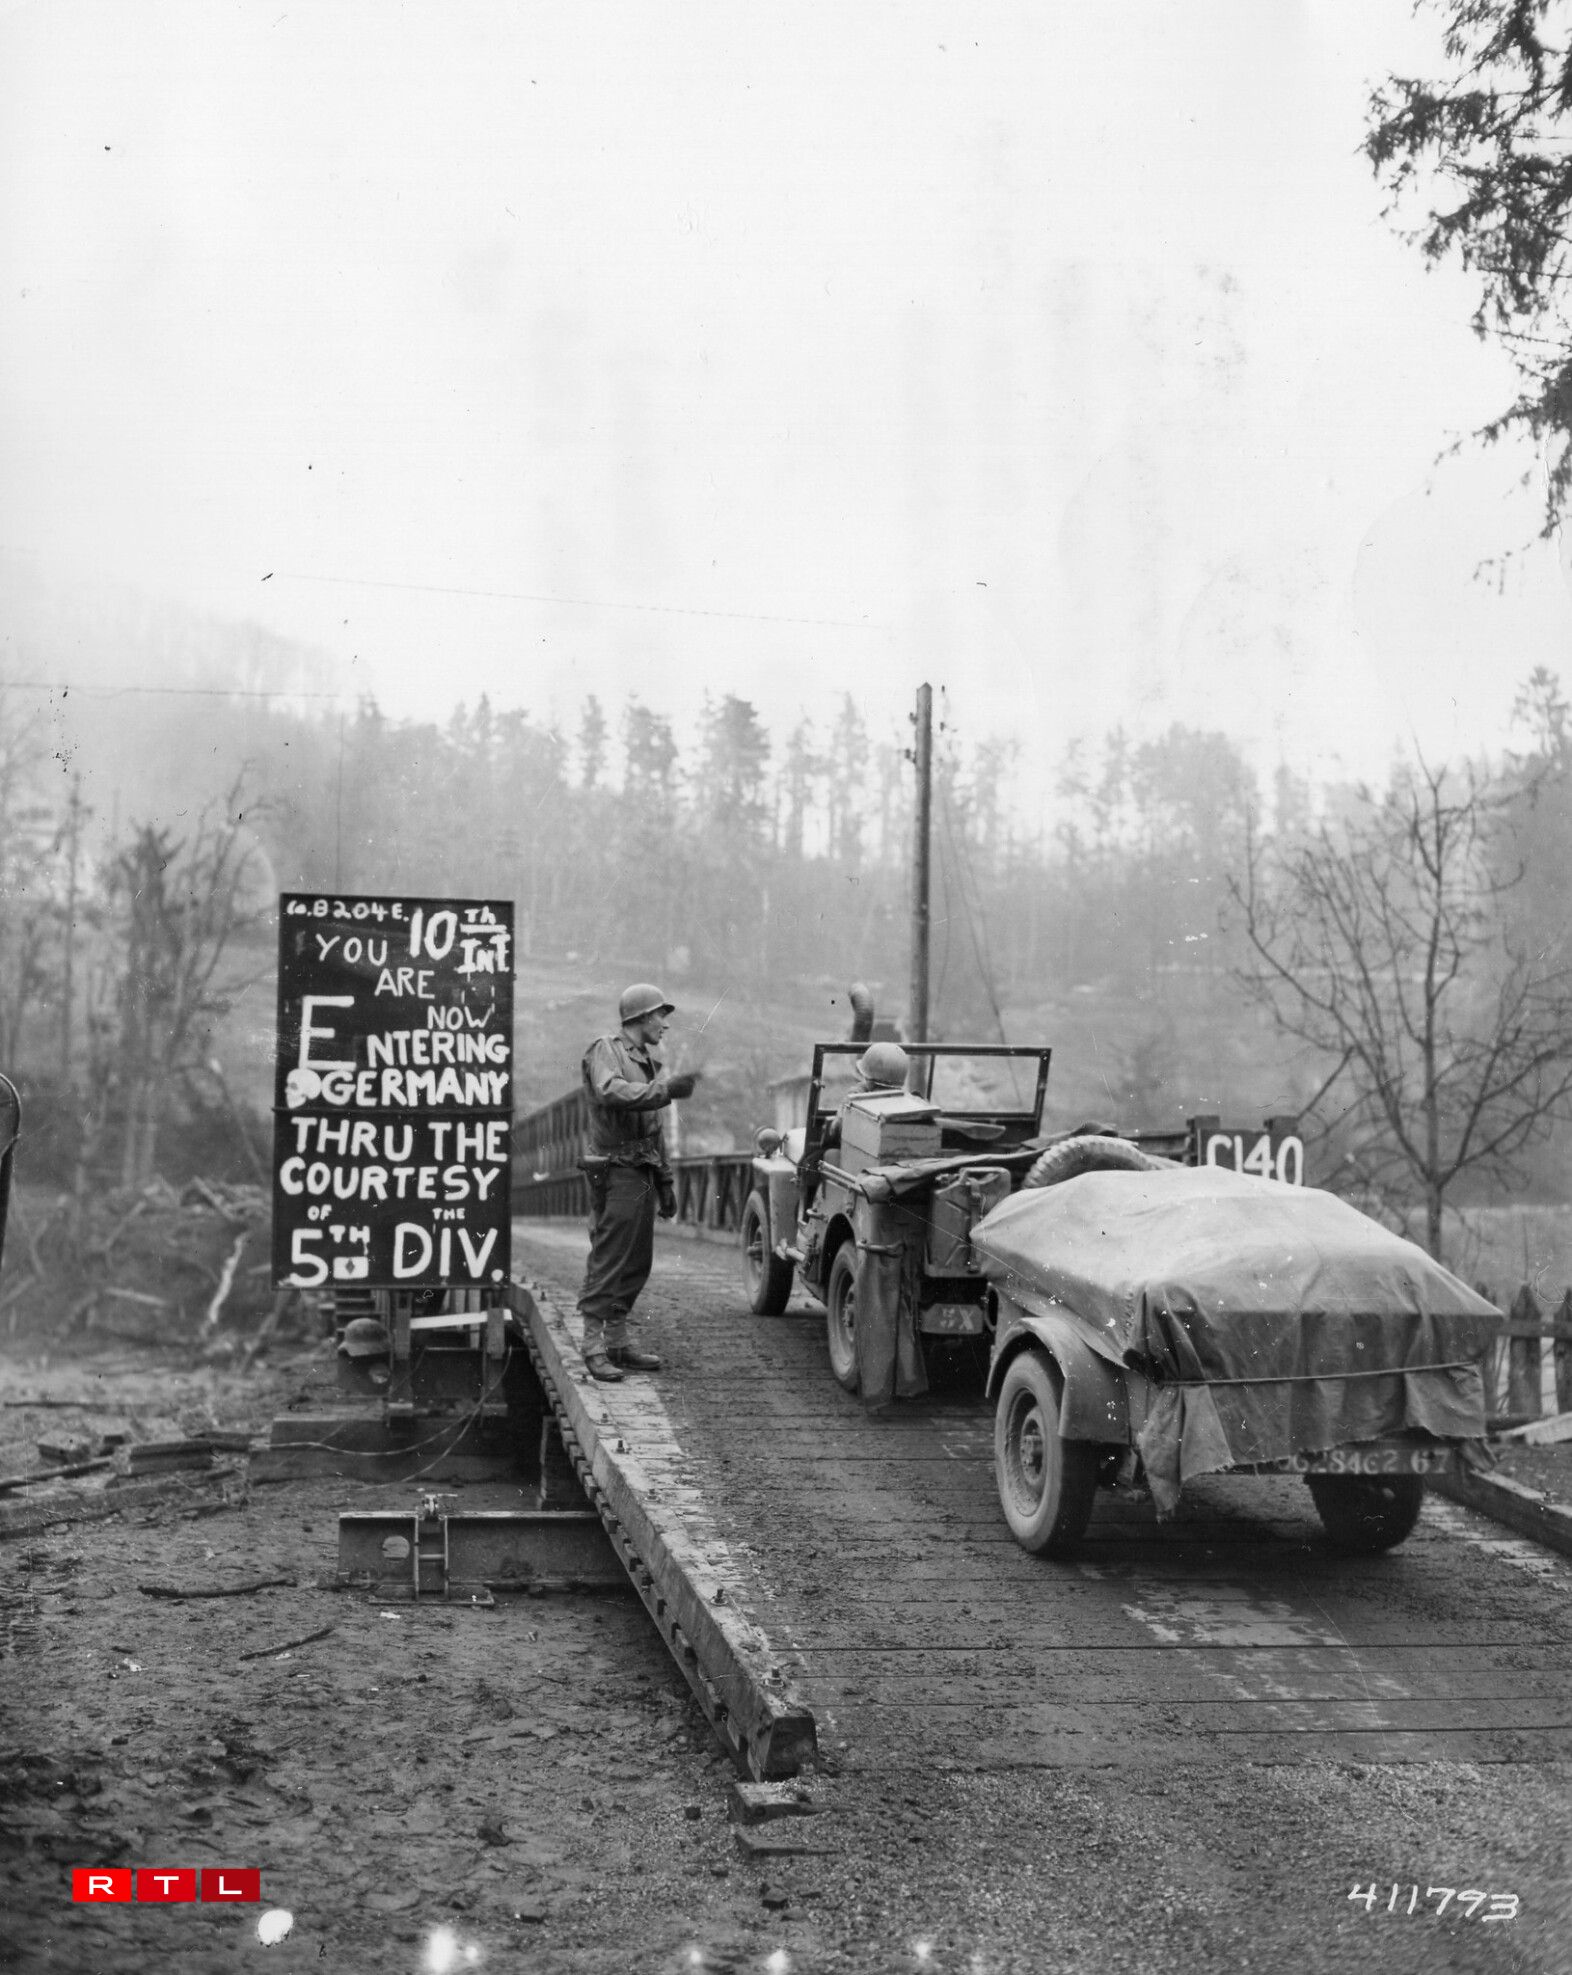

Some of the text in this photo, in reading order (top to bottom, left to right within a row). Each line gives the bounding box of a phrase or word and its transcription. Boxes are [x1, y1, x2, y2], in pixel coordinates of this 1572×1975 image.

[315, 933, 388, 967] YOU
[374, 967, 435, 999] ARE
[427, 1004, 496, 1031] NOW
[321, 1067, 509, 1107] GERMANY
[291, 1117, 509, 1163] THRU THE
[279, 1156, 500, 1201] COURTESY
[306, 1204, 466, 1221] OF THE
[393, 1222, 504, 1279] DIV.
